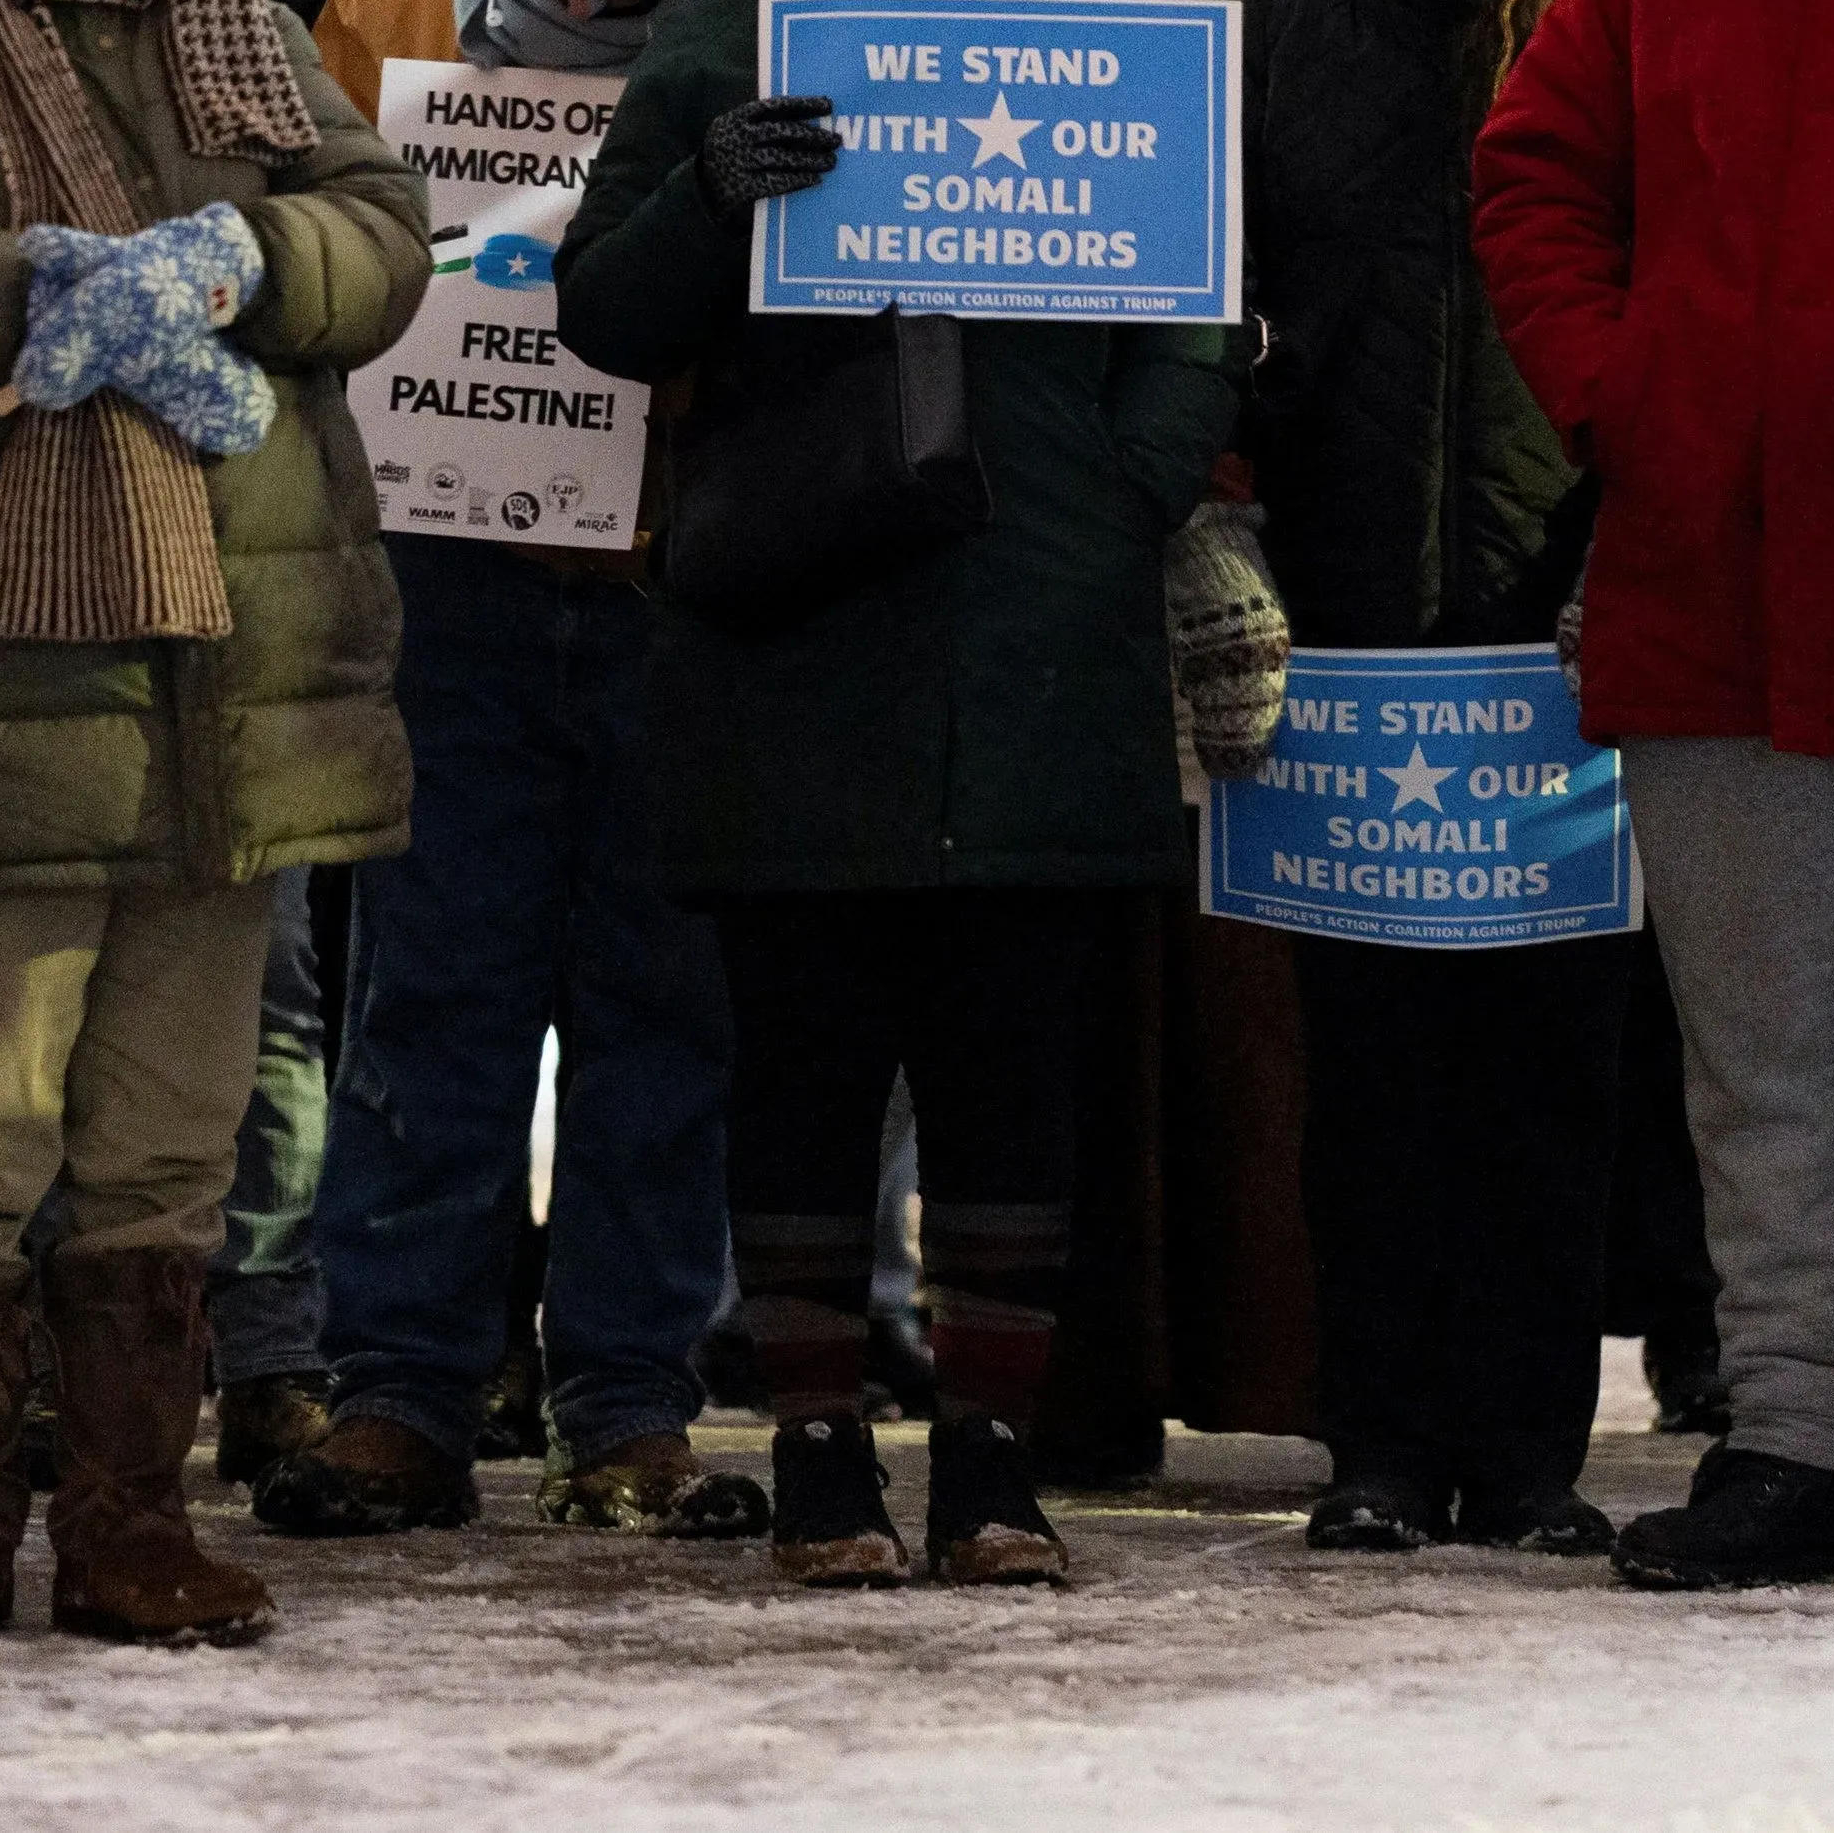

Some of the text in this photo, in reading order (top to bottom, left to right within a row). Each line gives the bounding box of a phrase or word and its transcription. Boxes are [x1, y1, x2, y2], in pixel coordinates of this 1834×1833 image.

[865, 44, 1120, 86] WE STAND
[426, 91, 615, 135] HANDS OF
[819, 114, 1159, 160] WITH OUR
[402, 143, 591, 190] IMMIGRAN
[903, 175, 1092, 215] SOMALI
[837, 224, 1137, 268] NEIGHBORS
[813, 287, 1178, 312] PEOPLE'S ACTION COALITION AGAINST TRUMP
[462, 322, 558, 367] FREE
[389, 375, 615, 432] PALESTINE!
[1286, 699, 1534, 735] WE STAND
[1256, 757, 1569, 799] WITH OUR
[1327, 817, 1508, 853] SOMALI
[1273, 850, 1550, 901] NEIGHBORS
[1255, 903, 1587, 940] PEOPLE'S ACTION COALITION AGAINST TRUMP
